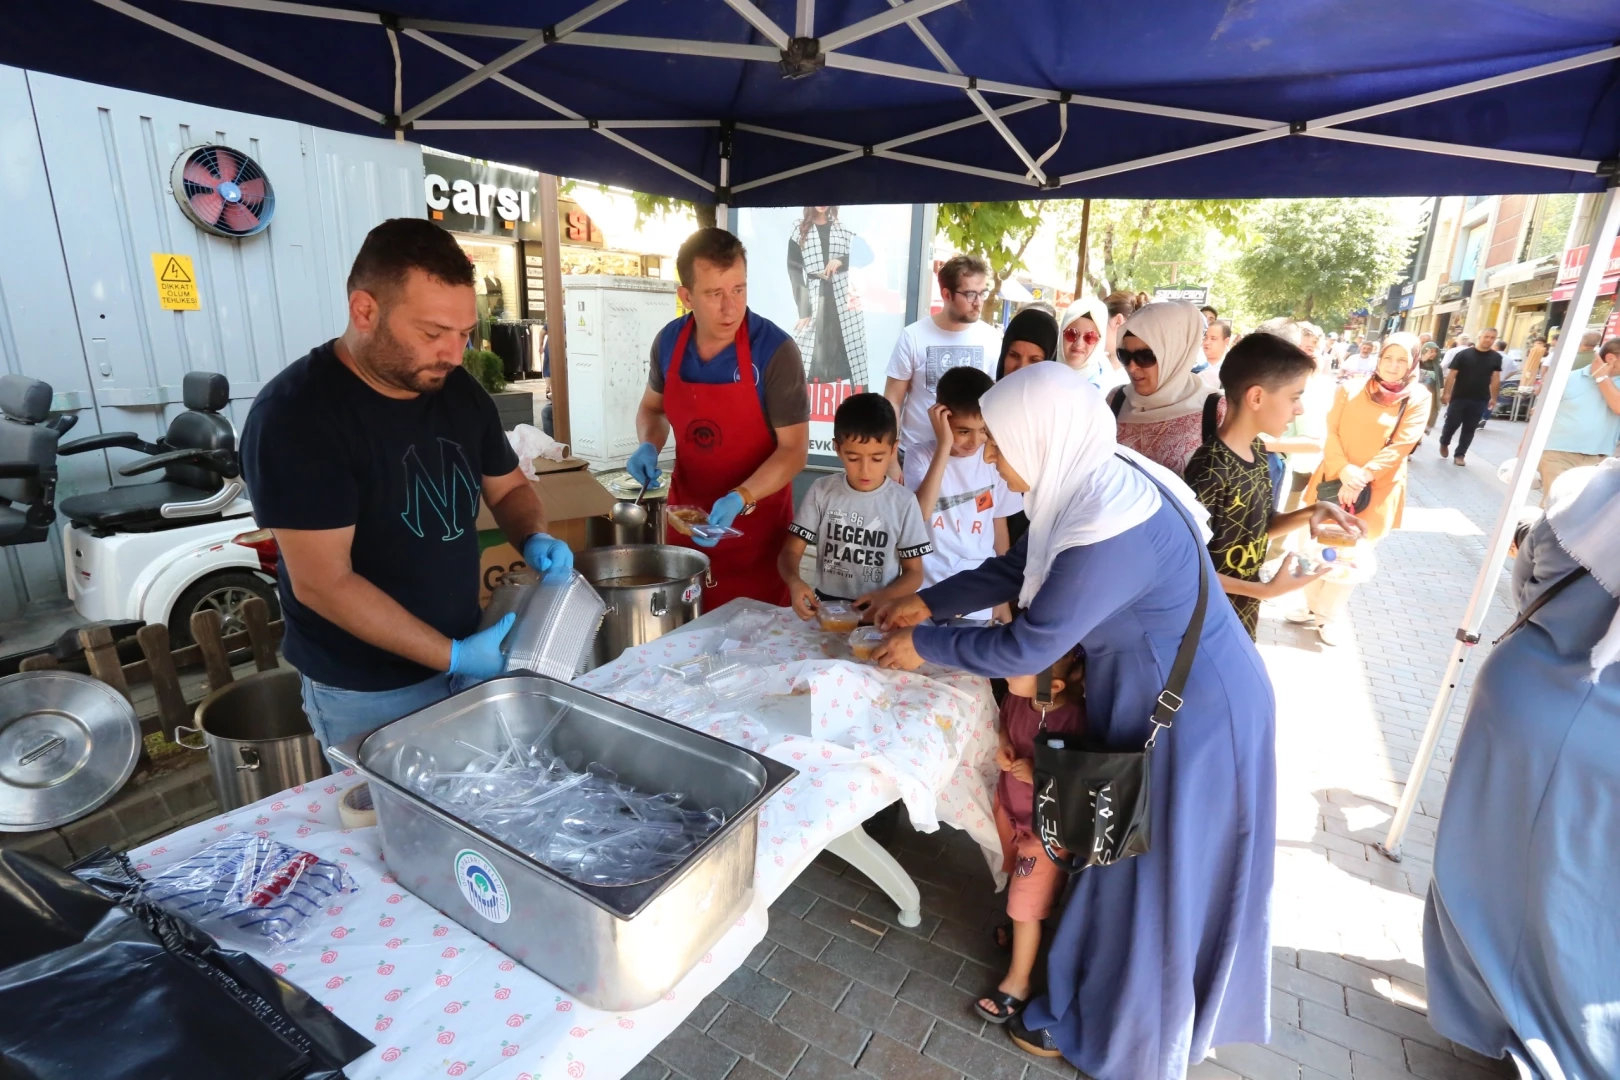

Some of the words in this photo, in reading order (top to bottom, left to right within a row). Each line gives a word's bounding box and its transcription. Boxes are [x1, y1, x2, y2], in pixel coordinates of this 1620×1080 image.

[809, 440, 835, 451] EVK
[850, 512, 864, 526] 96
[933, 515, 982, 534] AIR
[827, 522, 889, 548] LEGEND
[824, 542, 886, 567] PLACES
